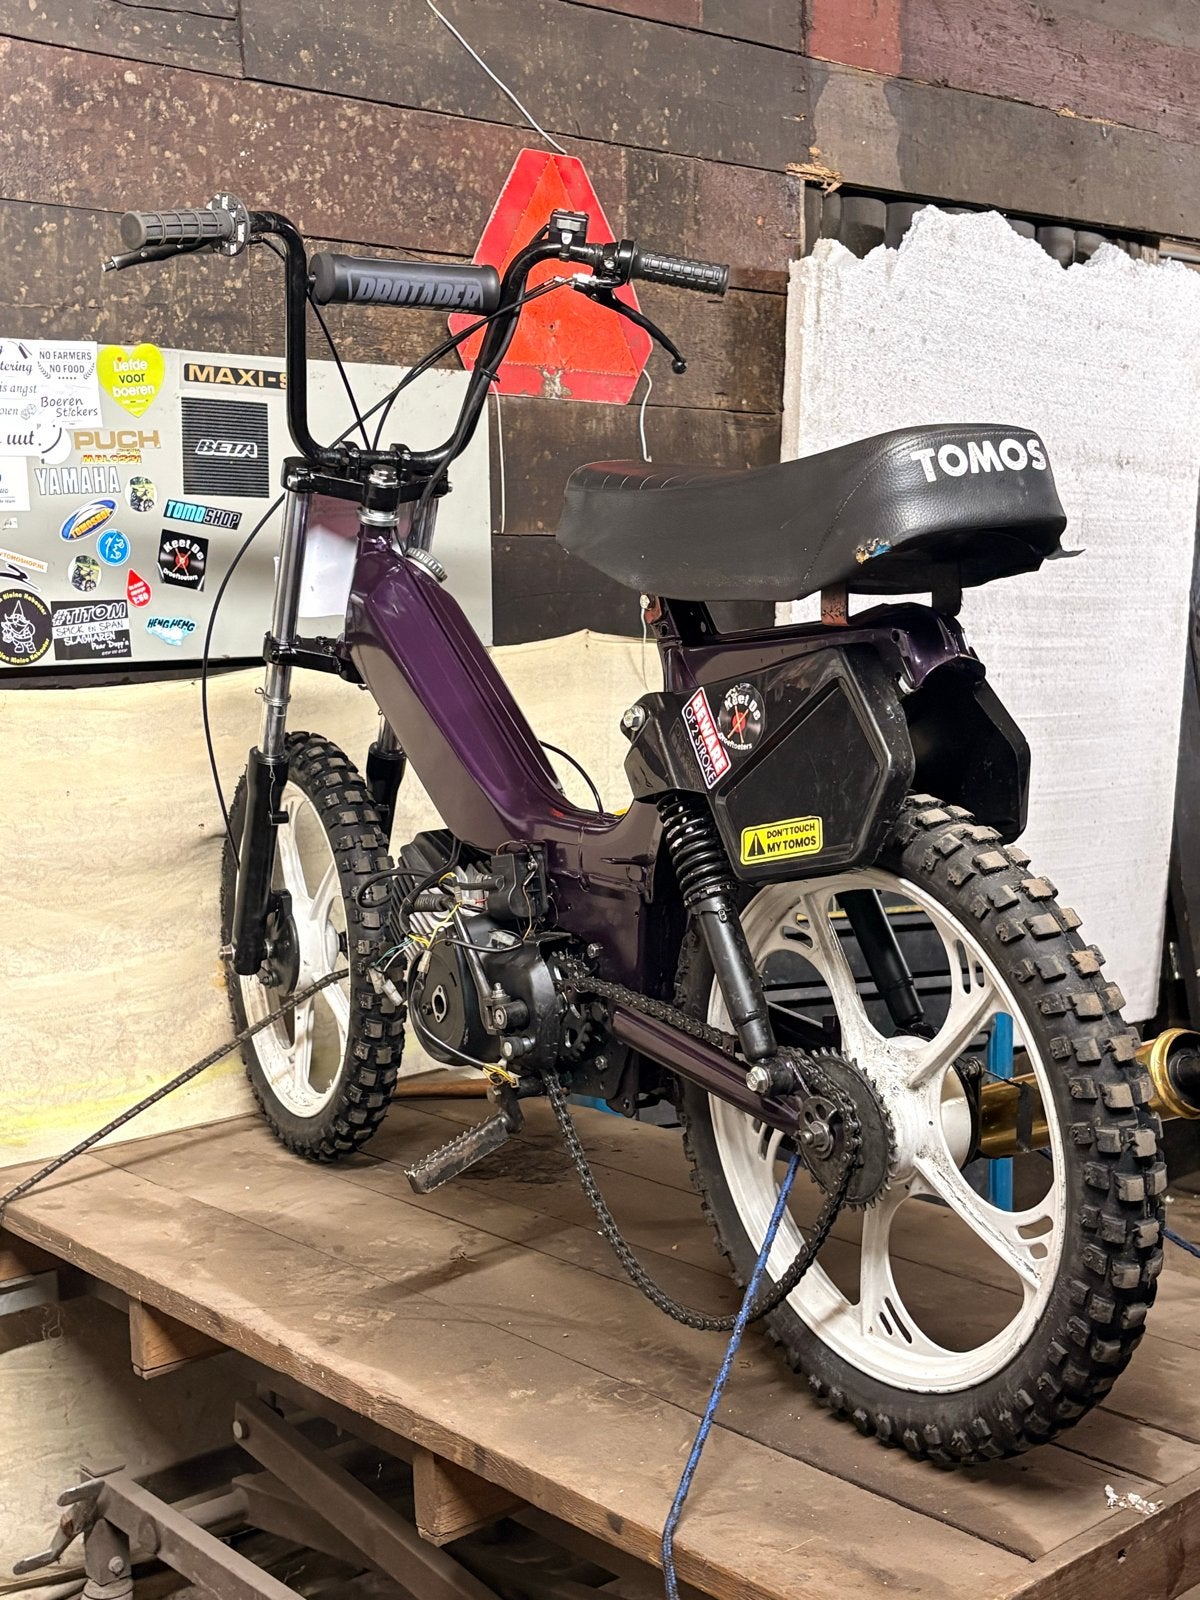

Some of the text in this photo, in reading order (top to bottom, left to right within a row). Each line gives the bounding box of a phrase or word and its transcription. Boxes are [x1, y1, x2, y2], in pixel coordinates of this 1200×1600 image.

[39, 351, 92, 361] NO FARMERS
[49, 364, 85, 374] NO FOOD
[113, 357, 148, 373] Liefde
[118, 373, 145, 384] voor
[112, 385, 155, 398] boeren
[40, 396, 83, 408] Boeren
[73, 430, 161, 450] PUCH
[195, 439, 258, 459] BETA
[910, 438, 1047, 482] TOMOS
[34, 466, 122, 495] YAMAHA
[52, 602, 127, 626] #TITOM
[98, 620, 124, 632] SPAN
[691, 692, 728, 776] BEWARE
[685, 706, 717, 783] OF 2 STROKE
[767, 823, 815, 839] DON'T TOUCH
[767, 836, 816, 853] MY TOMOS
